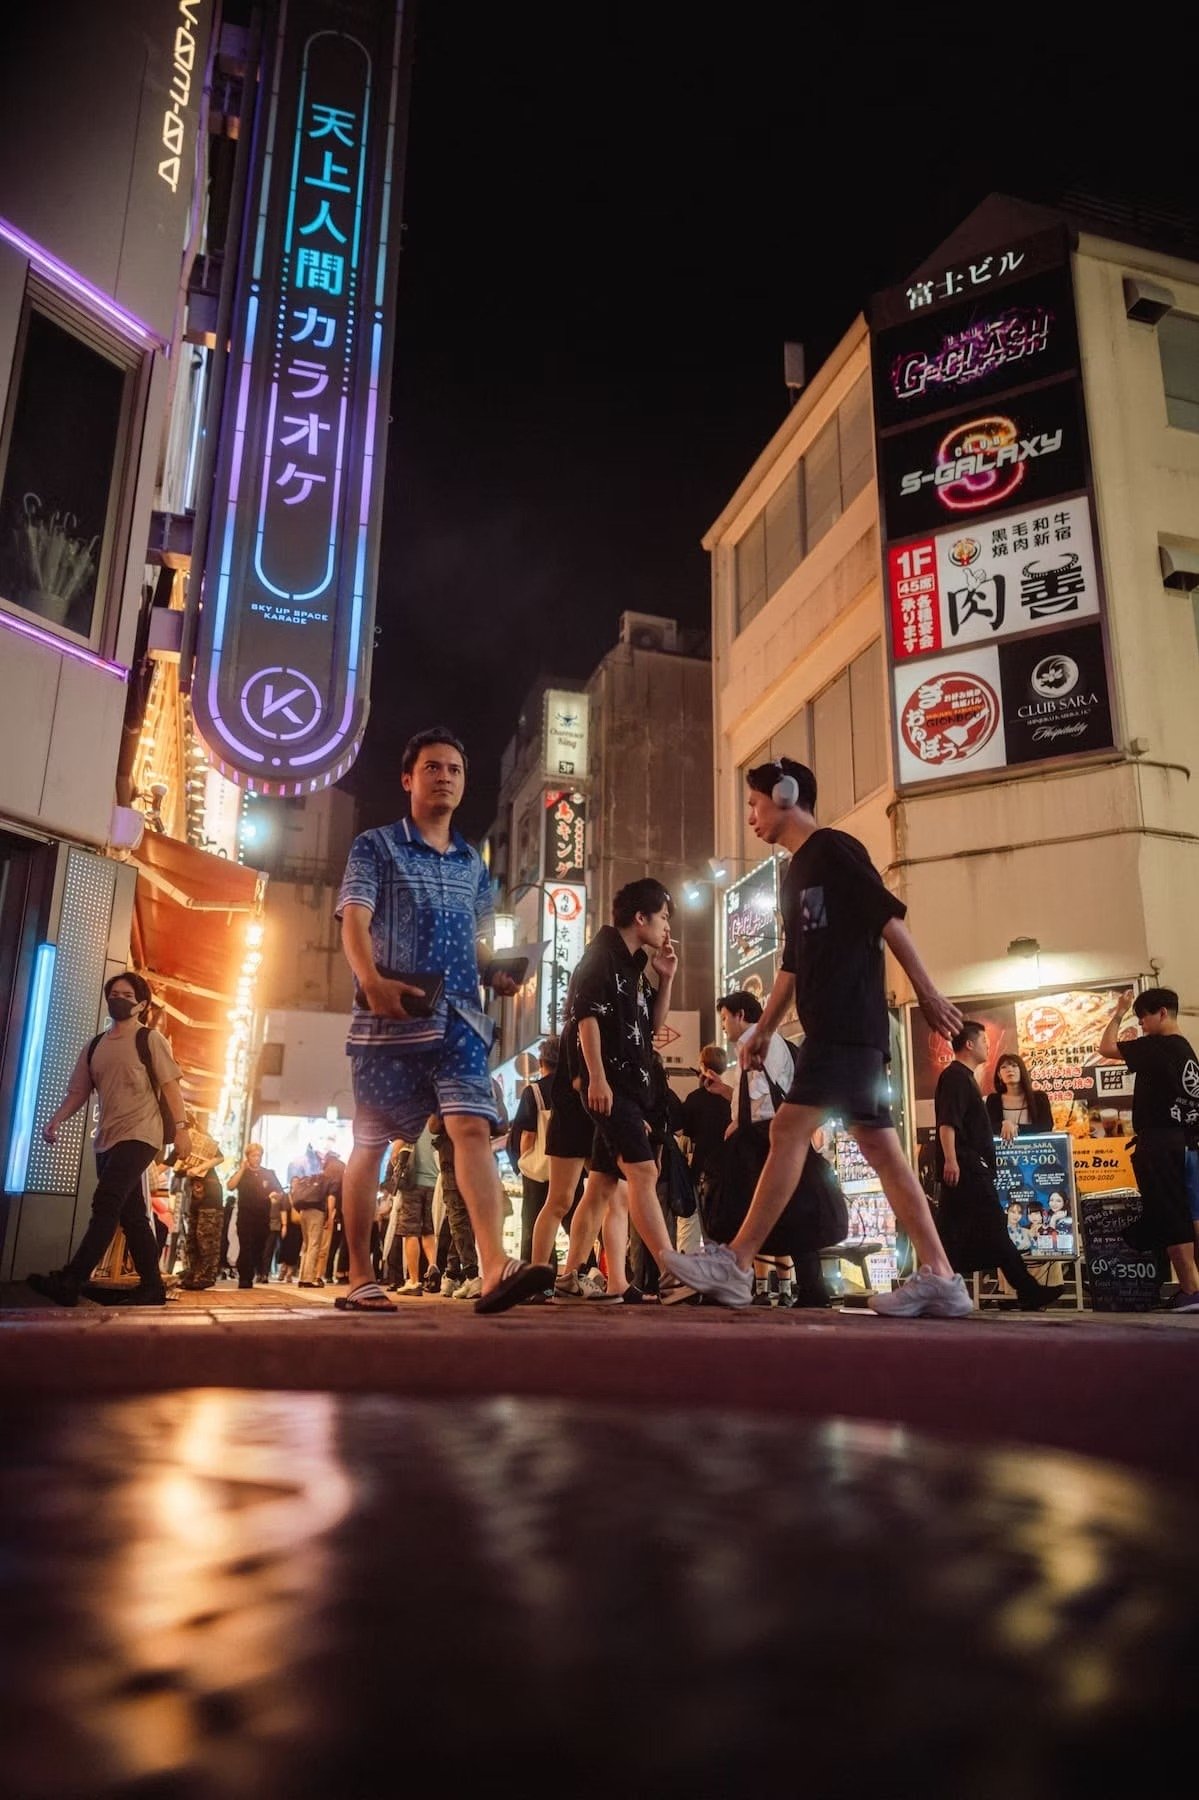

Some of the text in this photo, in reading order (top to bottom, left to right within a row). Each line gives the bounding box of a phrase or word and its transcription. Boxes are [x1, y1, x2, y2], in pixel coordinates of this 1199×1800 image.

[906, 251, 1025, 311] 富士ビル
[275, 103, 356, 505] 天上人間カラオケ
[900, 428, 1063, 497] S-GALAXY
[991, 511, 1072, 545] 黒毛和牛
[897, 545, 933, 579] 1F
[251, 603, 329, 622] SKY UP SPACE
[1017, 700, 1056, 719] CLUB
[1059, 693, 1098, 711] SARA
[1092, 1156, 1119, 1169] Bou
[1091, 1258, 1109, 1275] 60
